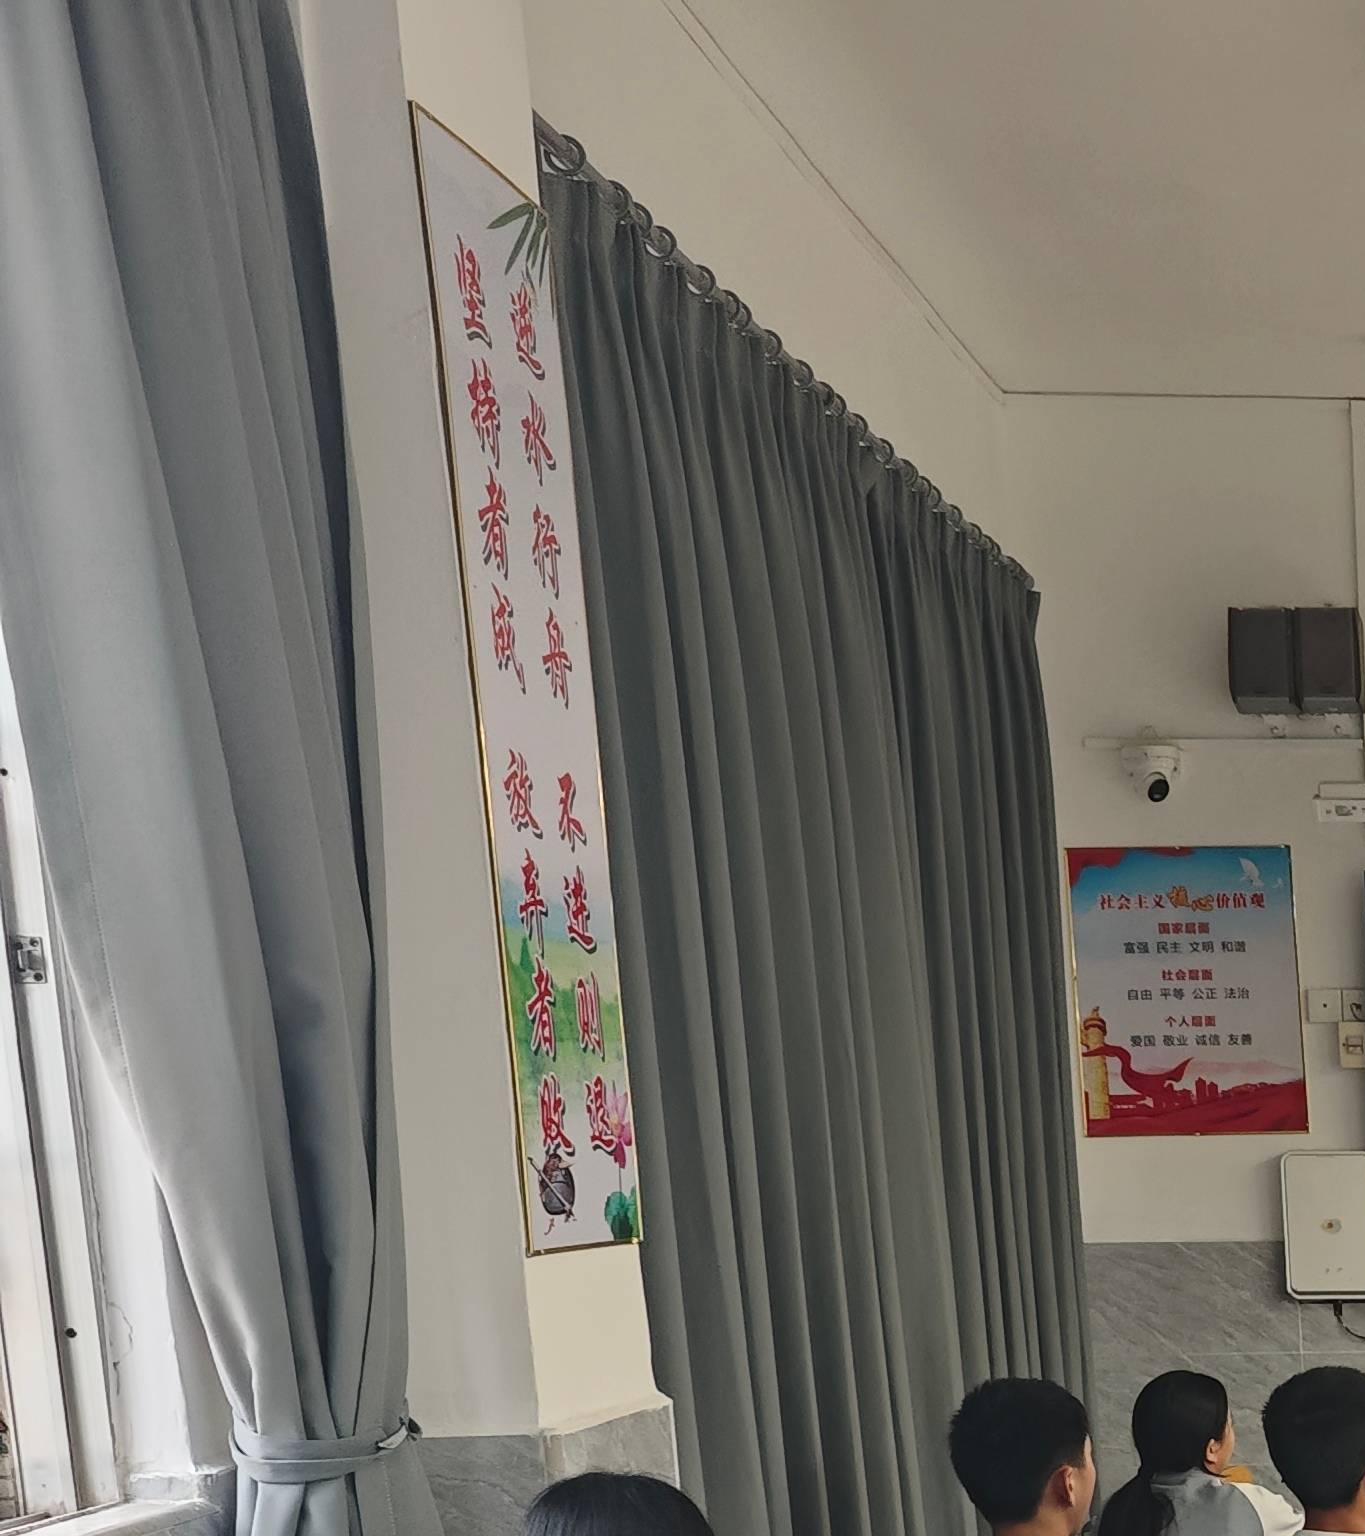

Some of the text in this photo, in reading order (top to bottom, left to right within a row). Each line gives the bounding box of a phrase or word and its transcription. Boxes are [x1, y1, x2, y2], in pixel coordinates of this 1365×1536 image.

[454, 233, 575, 1155] 坚持者成 放弃者败
[508, 278, 618, 1154] 逆水行舟 不进则退
[1124, 940, 1246, 954] 富强 民主 文明 和谐
[1127, 987, 1250, 1001] 自由 平等 公正 法治
[1130, 1033, 1252, 1047] 爱国 敬业 诚信 友善
